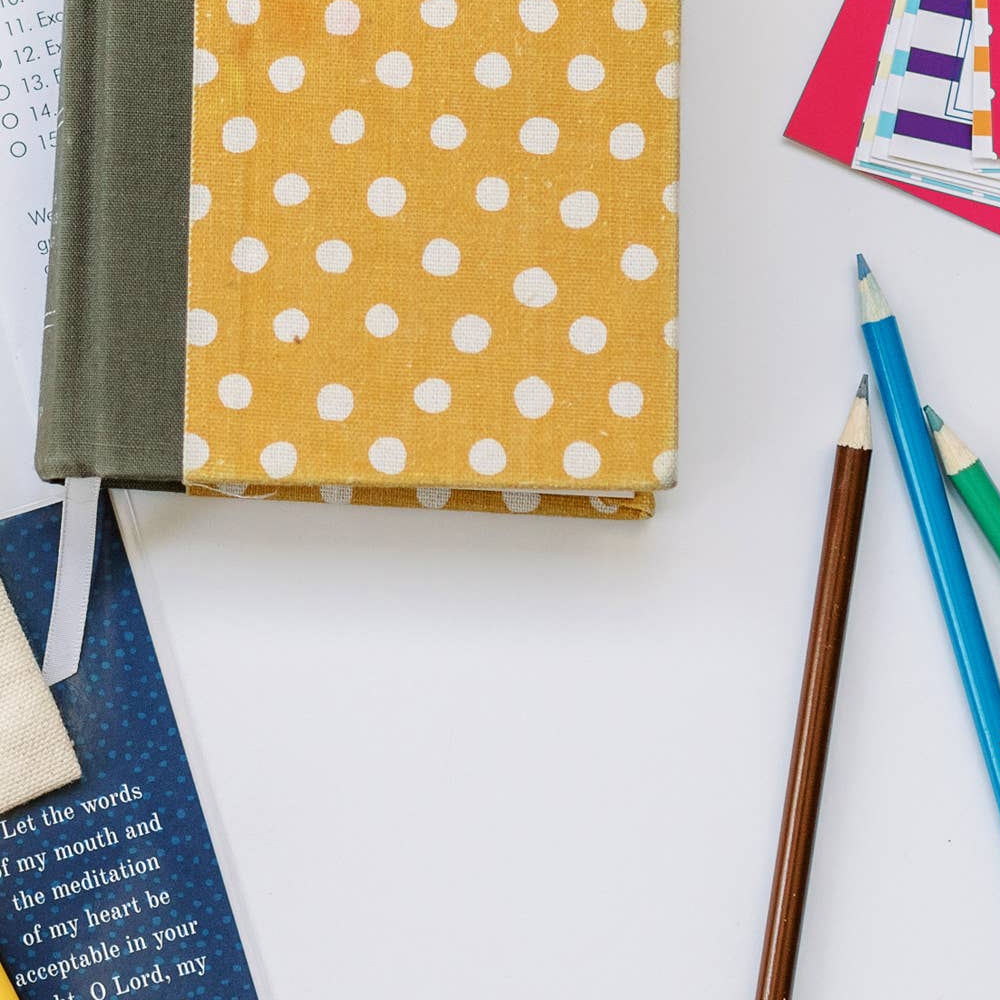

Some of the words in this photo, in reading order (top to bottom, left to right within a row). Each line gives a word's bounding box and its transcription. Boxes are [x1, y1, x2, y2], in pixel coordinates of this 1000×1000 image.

[5, 18, 33, 36] 11.
[13, 46, 41, 65] 12.
[21, 74, 49, 93] 13.
[30, 103, 57, 121] 14.
[0, 814, 37, 840] Let
[41, 806, 75, 827] the
[80, 783, 143, 815] words
[16, 852, 47, 872] my
[54, 827, 120, 861] mouth
[125, 812, 164, 840] and
[12, 890, 46, 911] the
[51, 855, 161, 900] meditation
[22, 924, 43, 946] of
[49, 918, 80, 938] my
[85, 897, 142, 928] heart
[146, 890, 171, 909] be
[15, 942, 122, 987] acceptable
[125, 935, 147, 954] in
[152, 920, 199, 950] your
[111, 963, 172, 996] Lord,
[176, 956, 207, 976] my
